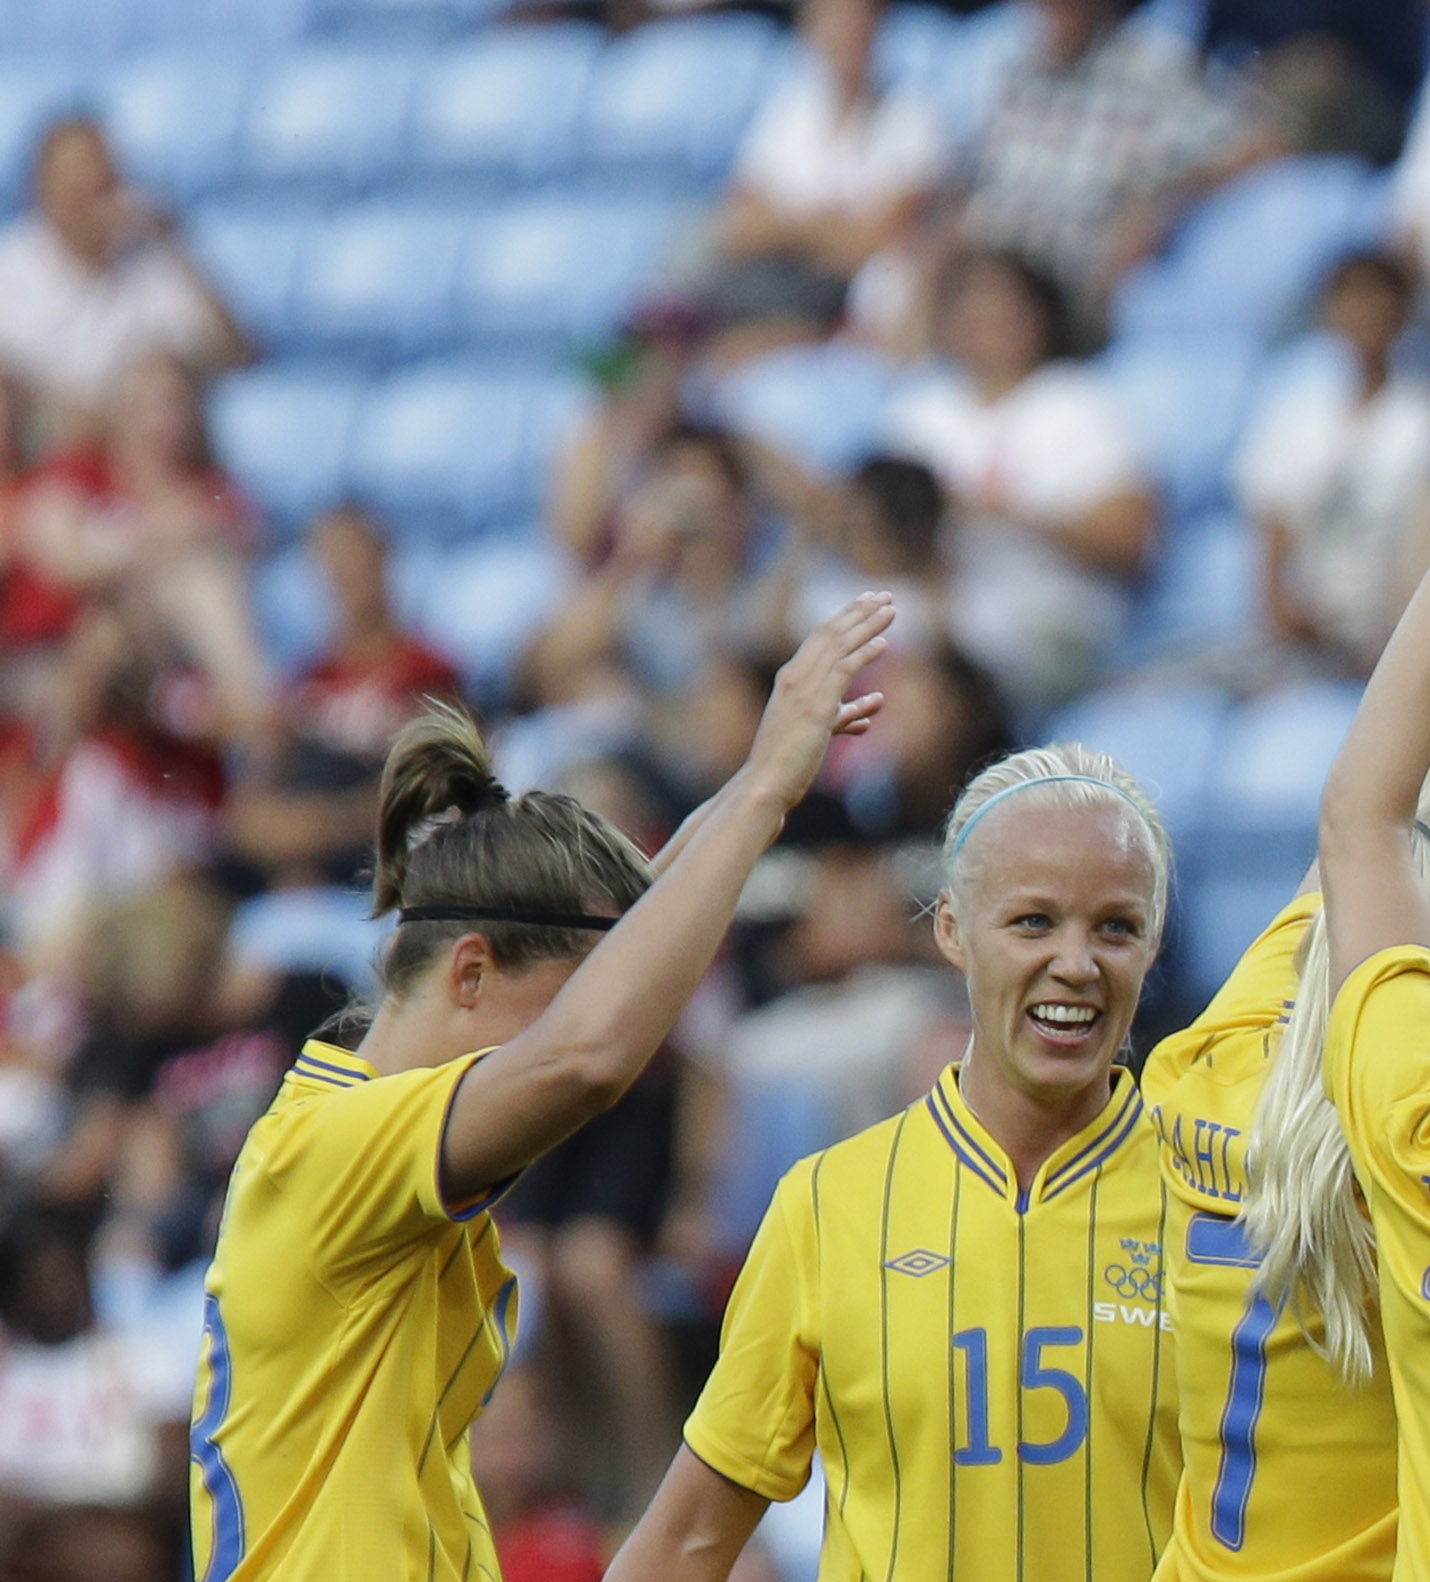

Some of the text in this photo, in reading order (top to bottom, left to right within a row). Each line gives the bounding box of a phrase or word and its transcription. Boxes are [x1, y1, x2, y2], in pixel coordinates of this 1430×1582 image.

[1093, 1302, 1175, 1332] SWE
[1186, 1212, 1290, 1552] 7
[952, 1326, 1089, 1466] 15
